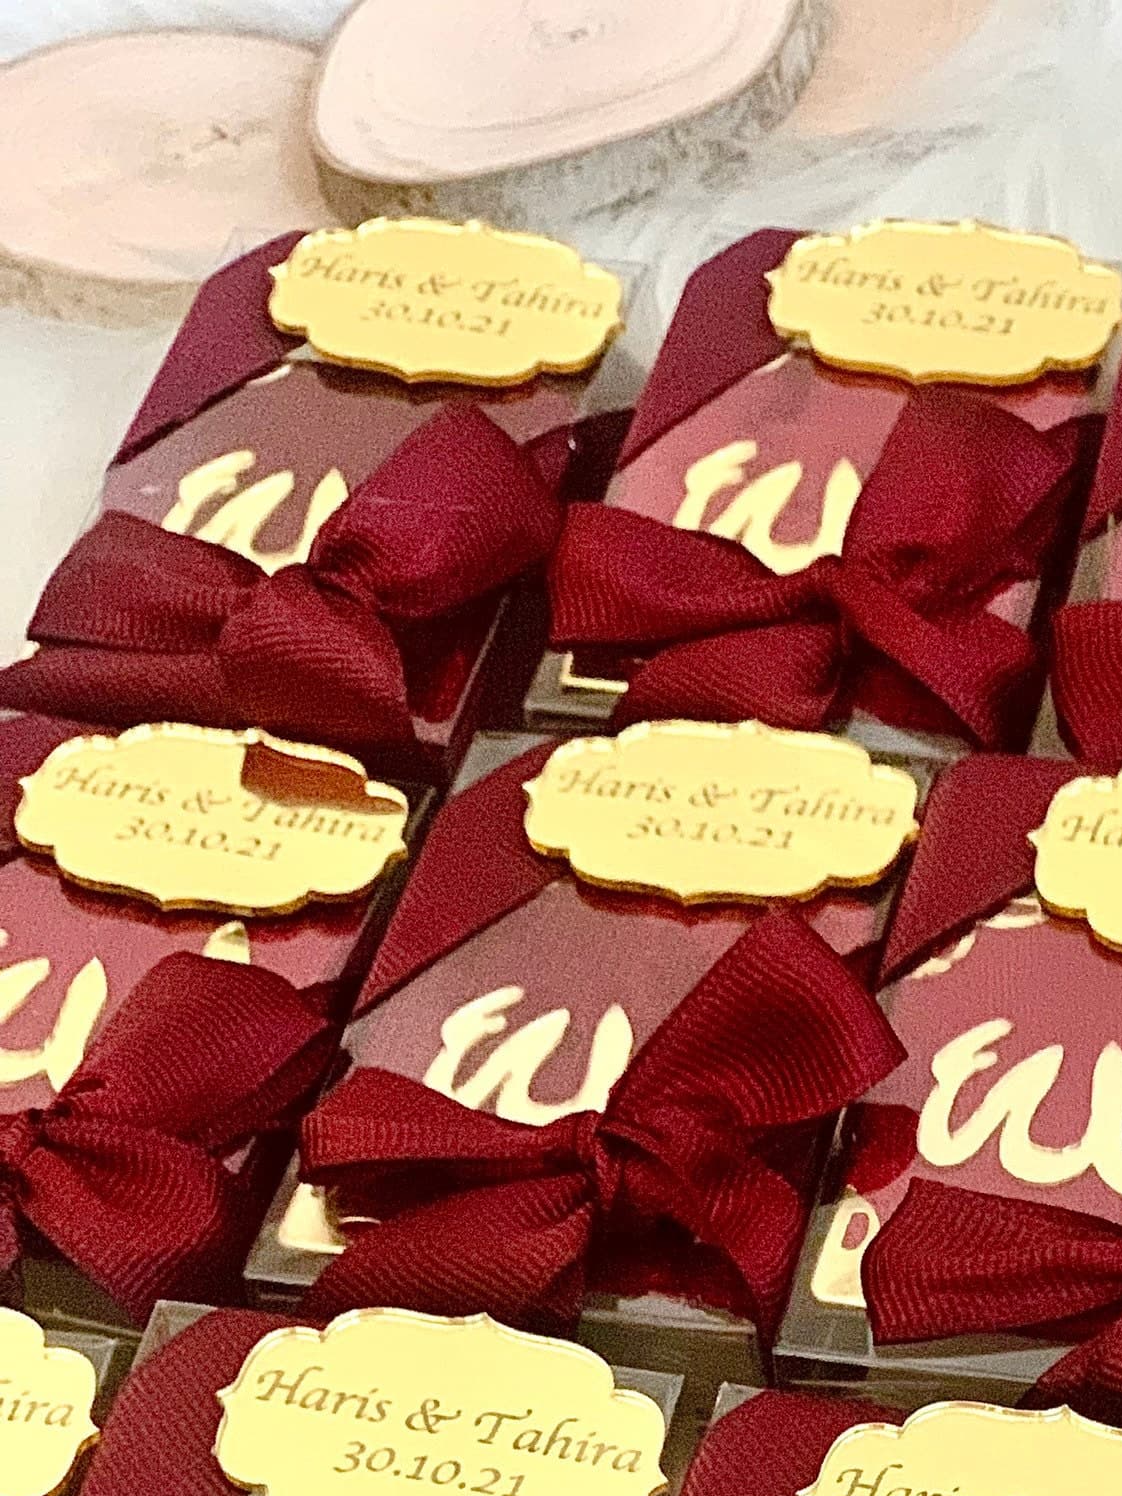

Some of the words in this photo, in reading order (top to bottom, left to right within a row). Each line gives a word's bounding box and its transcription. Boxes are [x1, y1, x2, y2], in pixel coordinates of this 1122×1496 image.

[300, 254, 404, 288] Haris
[418, 273, 461, 296] &
[471, 278, 604, 319] Tahira
[798, 258, 904, 291] Haris
[916, 274, 962, 298] &
[971, 277, 1109, 315] Tahira
[360, 301, 511, 337] 30.10.21
[862, 302, 1017, 334] 30.10.21
[55, 765, 167, 805] Haris
[182, 789, 232, 815] &
[559, 766, 671, 801] Haris
[689, 784, 737, 807] &
[751, 786, 895, 824] Tahira
[114, 816, 282, 861] 30.10.21
[627, 816, 792, 849] 30.10.21
[256, 1366, 392, 1422] Haris
[405, 1399, 461, 1433] &
[474, 1409, 642, 1472] Tahira
